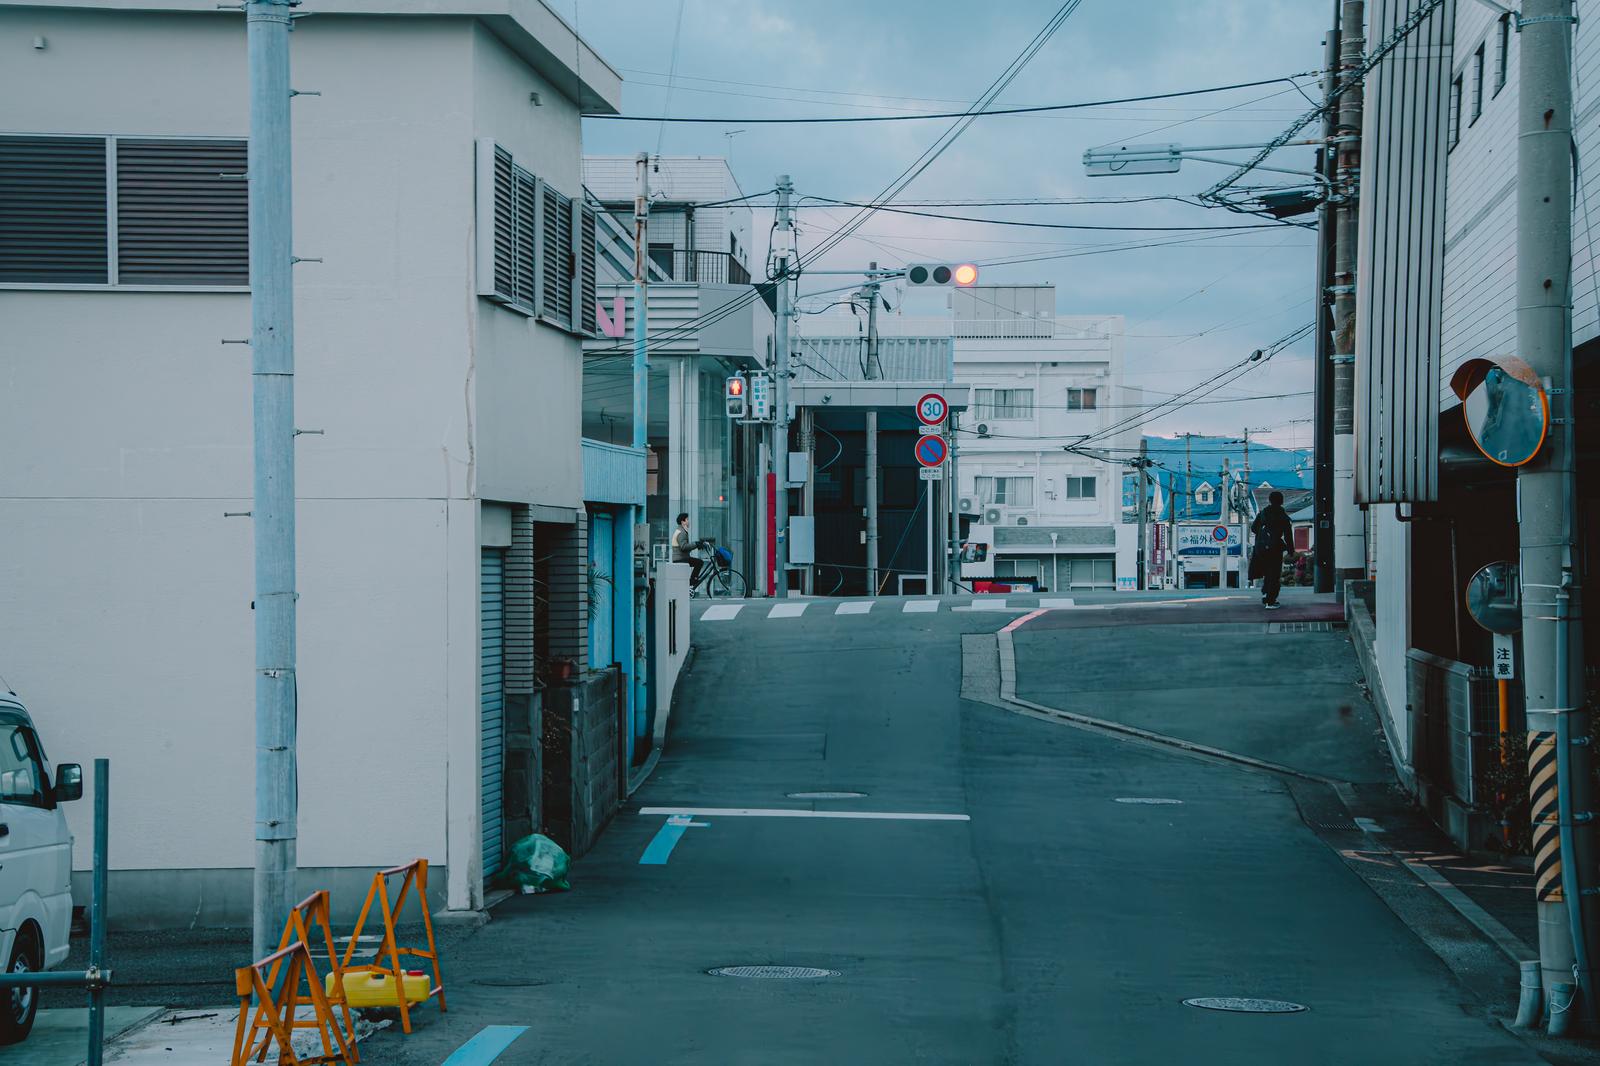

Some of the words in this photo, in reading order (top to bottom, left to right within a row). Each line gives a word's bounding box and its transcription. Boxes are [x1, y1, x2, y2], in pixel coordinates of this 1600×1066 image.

[923, 402, 941, 417] 30
[920, 426, 940, 434] ここから
[1496, 647, 1511, 675] 注意
